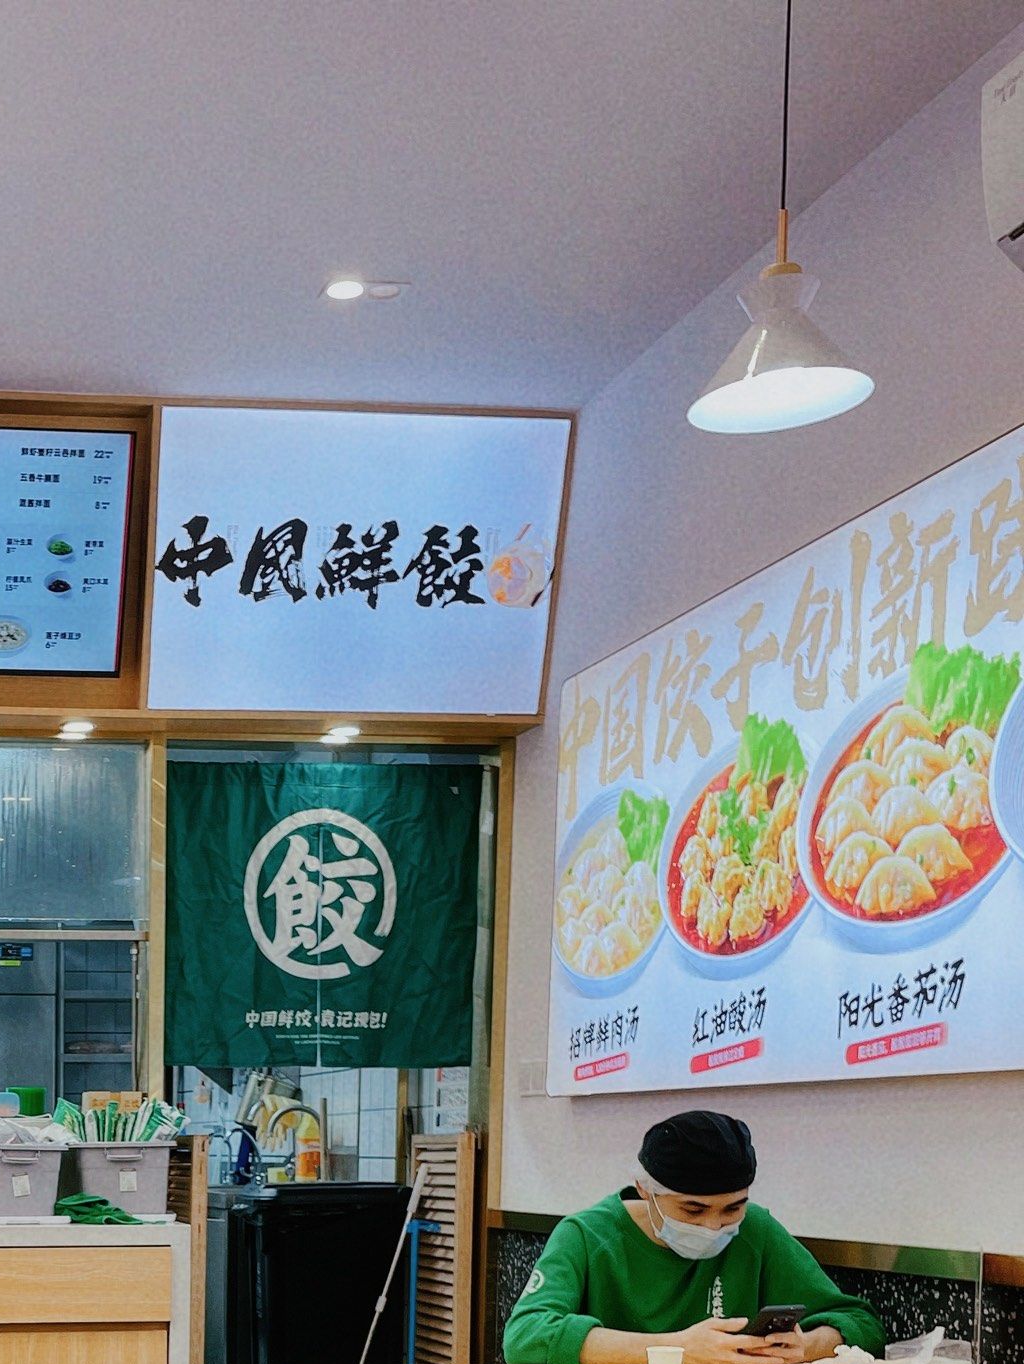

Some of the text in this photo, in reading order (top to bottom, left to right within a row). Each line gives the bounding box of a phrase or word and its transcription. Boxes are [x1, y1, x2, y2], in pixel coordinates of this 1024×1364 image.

[692, 986, 767, 1048] 红油酸汤
[837, 957, 965, 1040] 阳光番茄汤
